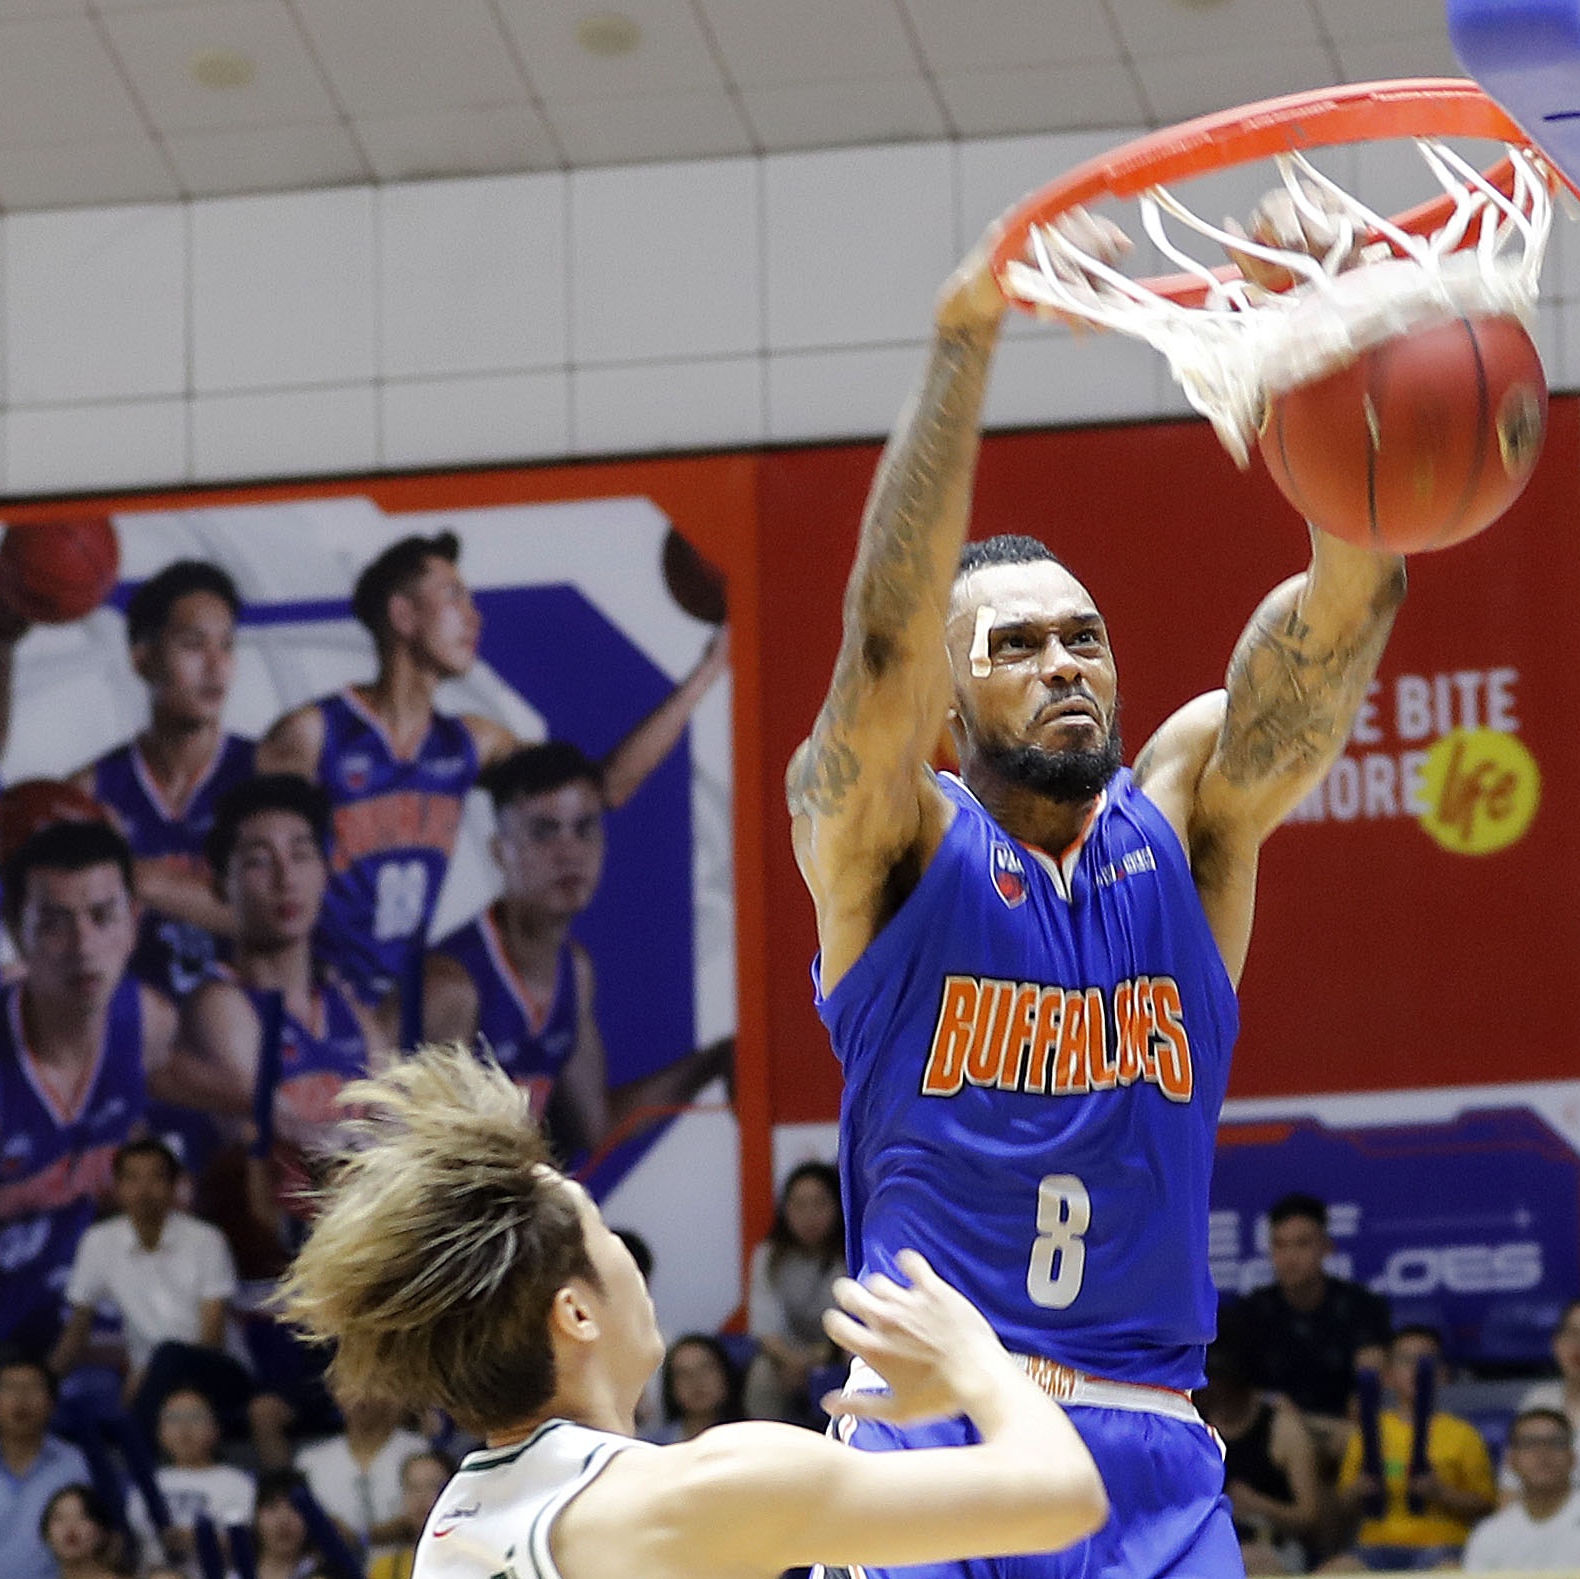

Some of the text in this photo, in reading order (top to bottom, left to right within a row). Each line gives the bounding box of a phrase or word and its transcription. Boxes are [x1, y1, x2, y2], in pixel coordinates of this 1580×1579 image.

[1395, 667, 1520, 740] BITE
[921, 975, 1193, 1103] BUFFALOES
[1026, 1174, 1092, 1311] 8
